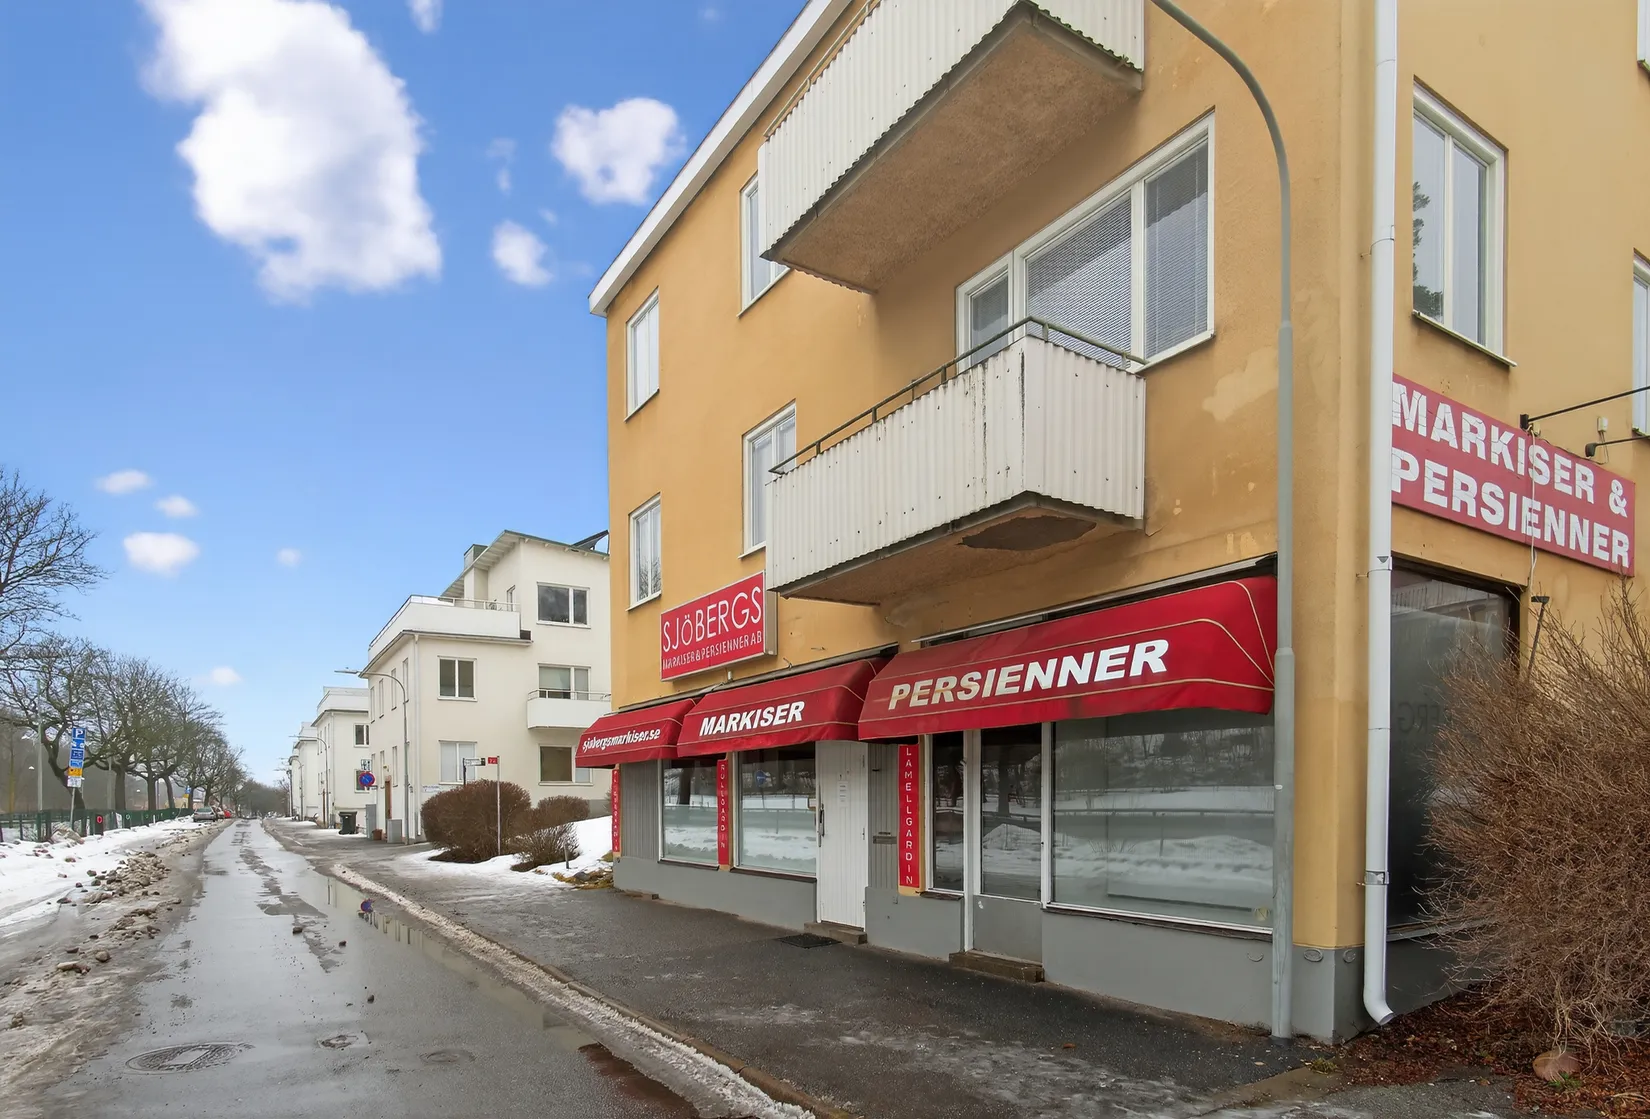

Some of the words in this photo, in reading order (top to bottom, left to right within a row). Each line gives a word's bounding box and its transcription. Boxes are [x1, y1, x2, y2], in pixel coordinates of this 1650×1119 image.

[1392, 382, 1595, 505] MARKISER
[1608, 479, 1628, 519] &
[1391, 449, 1630, 568] PERSIENNER
[663, 586, 762, 653] SJÖBERGS
[699, 700, 805, 737] MARKISER
[888, 638, 1169, 711] PERSIENNER
[904, 747, 913, 885] LAMELLGARDIN
